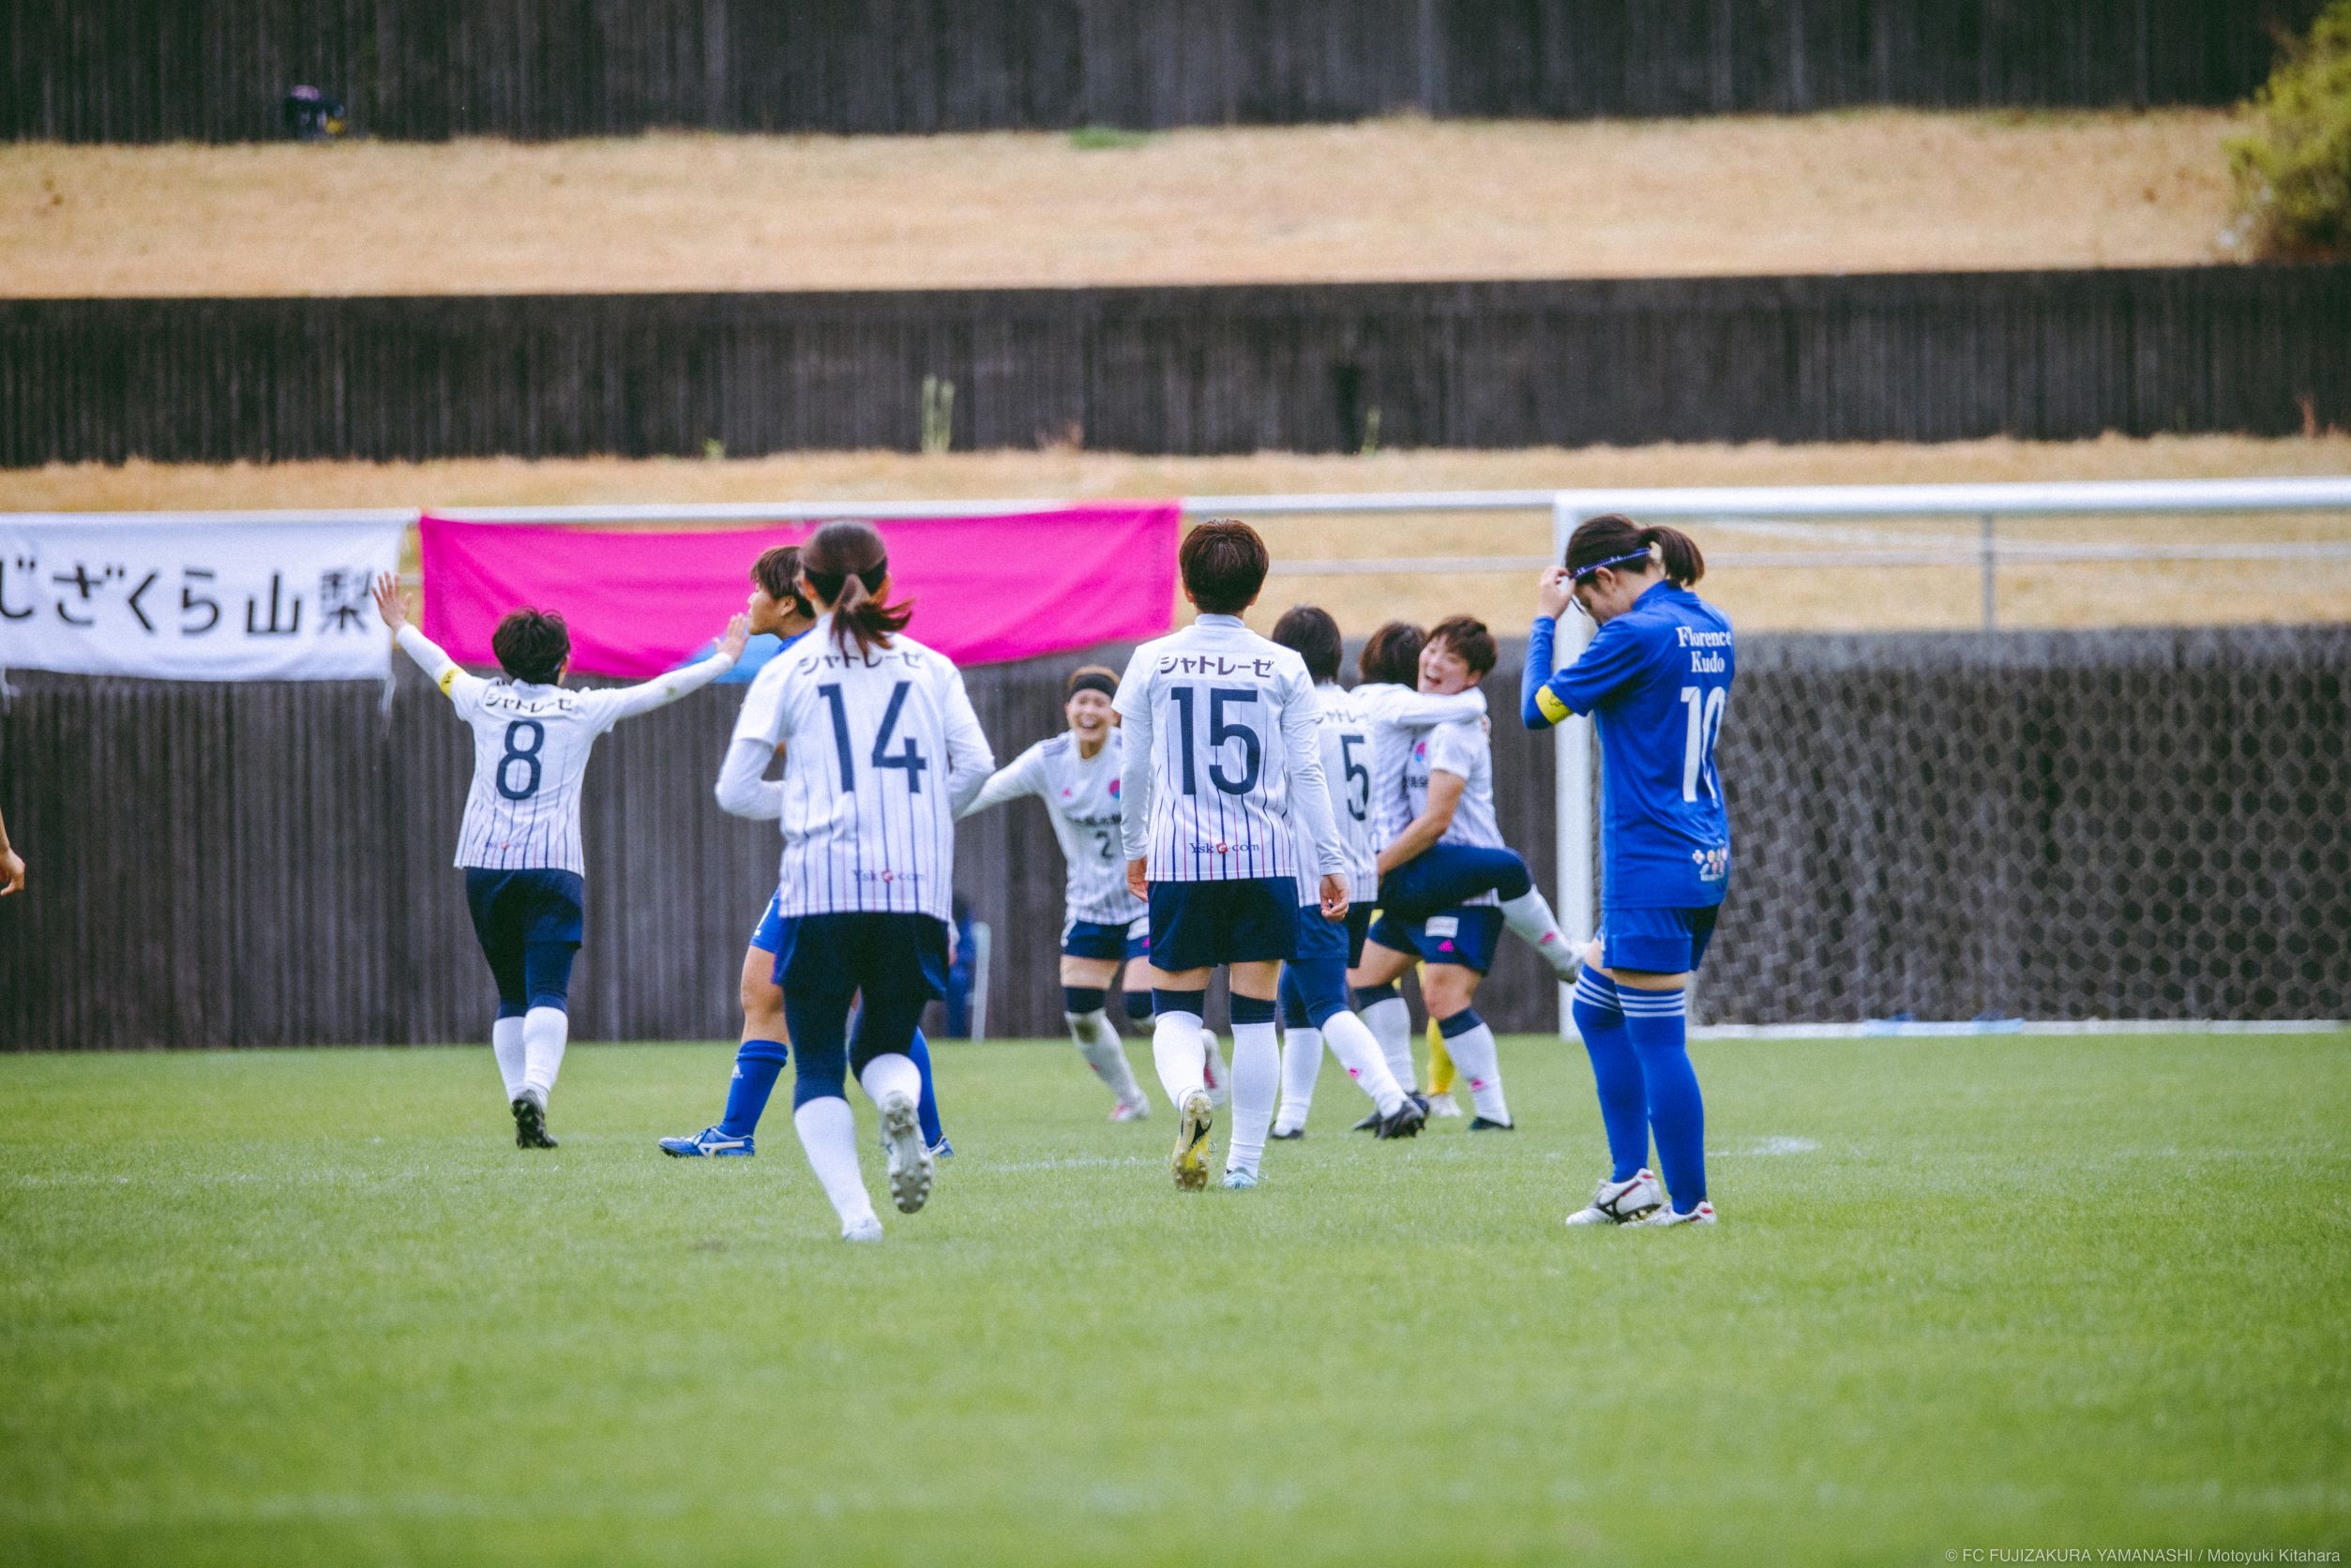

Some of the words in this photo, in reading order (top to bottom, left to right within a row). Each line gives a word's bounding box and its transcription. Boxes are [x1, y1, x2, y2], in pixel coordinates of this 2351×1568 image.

[1160, 656, 1274, 679] シャトレーゼ
[1675, 626, 1732, 647] Florence
[1690, 650, 1726, 673] Kudo
[496, 719, 545, 800] 8
[817, 681, 927, 794] 14
[1170, 686, 1261, 795] 15
[1340, 734, 1369, 822] 5
[1680, 686, 1726, 807] 10
